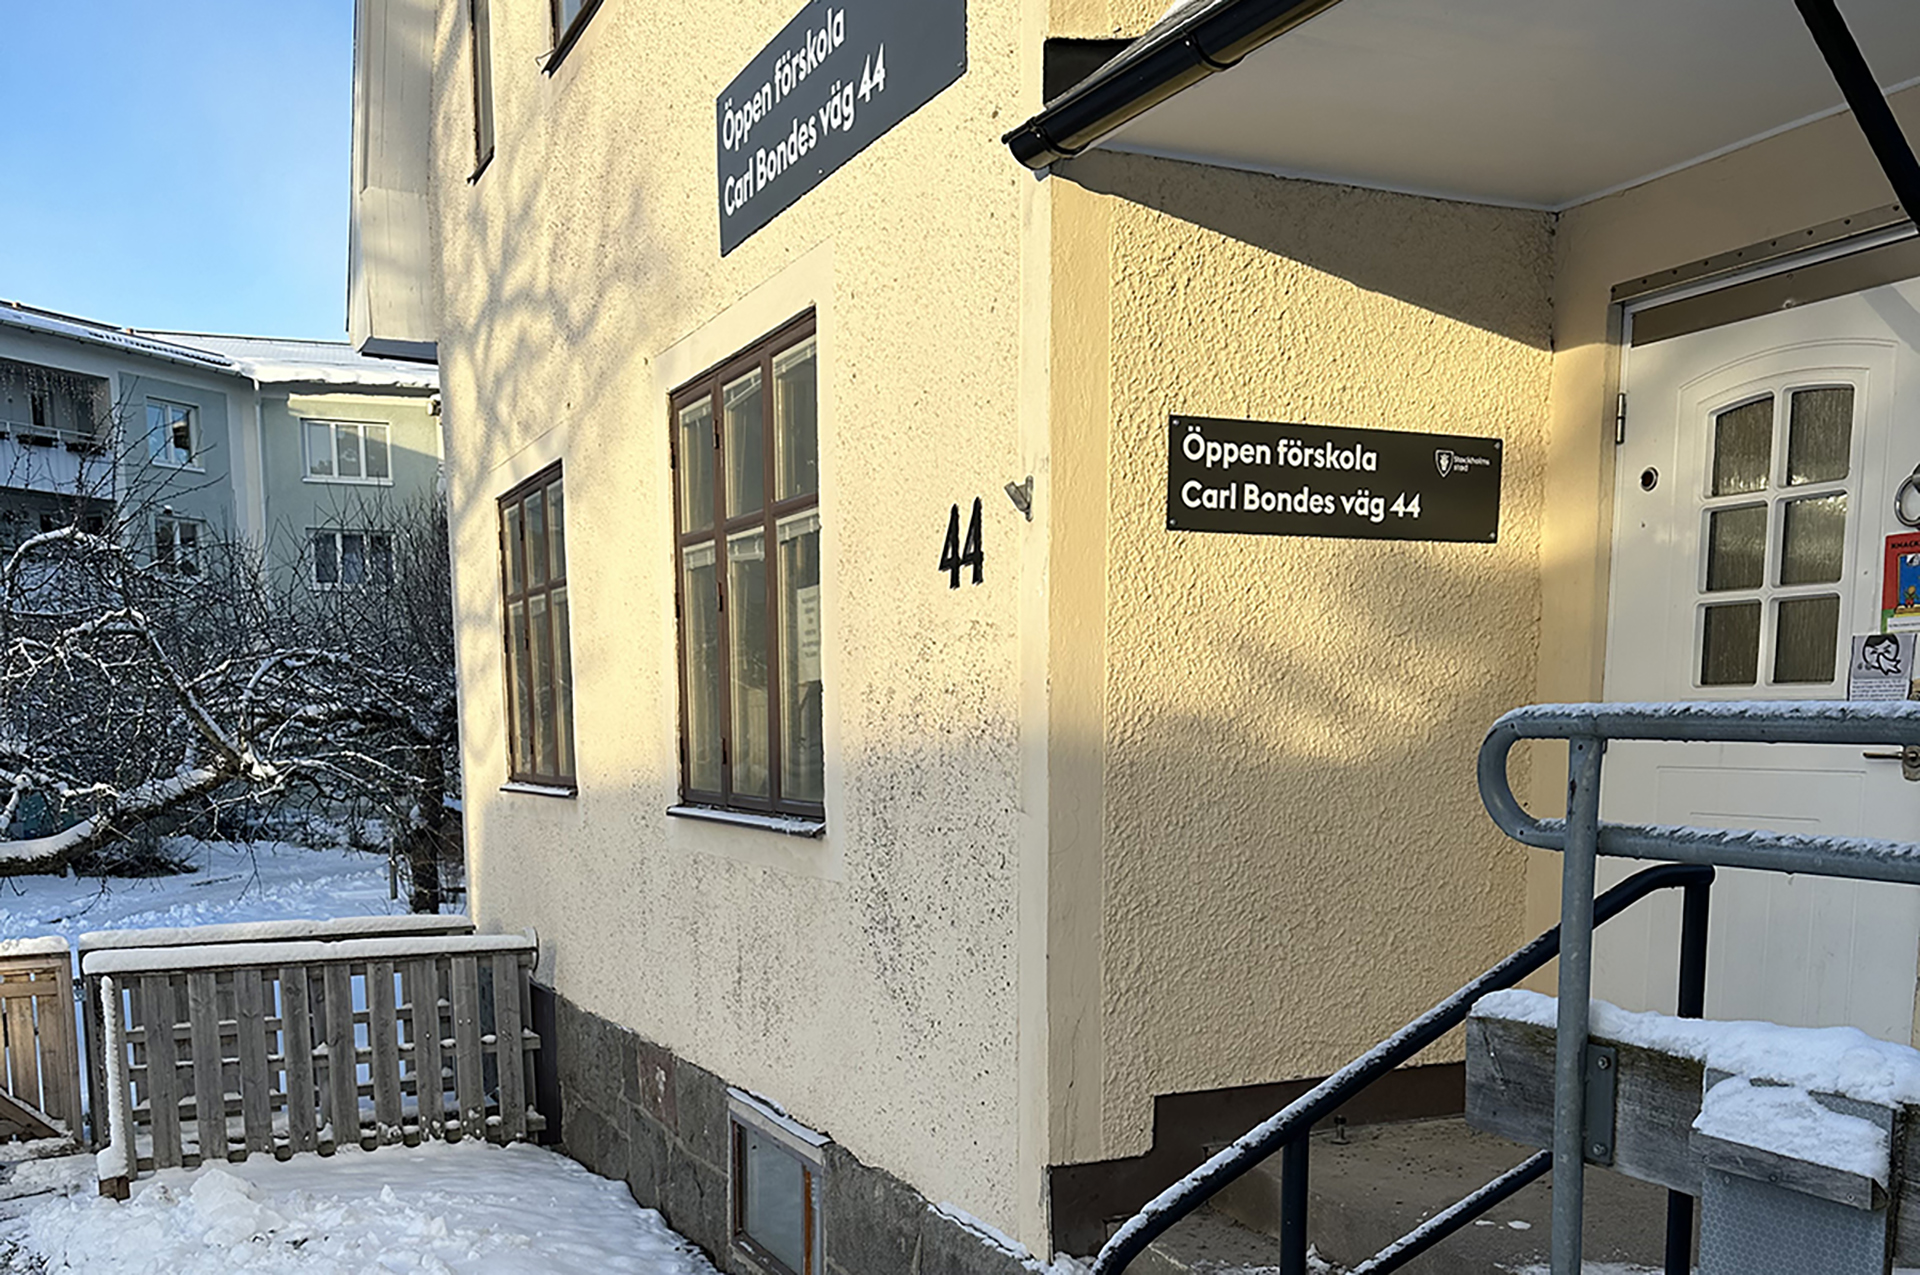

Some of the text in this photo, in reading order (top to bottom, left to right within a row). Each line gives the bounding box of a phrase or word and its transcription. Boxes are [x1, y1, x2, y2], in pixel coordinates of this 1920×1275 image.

[722, 7, 846, 152] Öppen förskola
[723, 43, 886, 216] Carl Bondes väg 44
[1182, 425, 1377, 471] Öppen förskola
[938, 496, 985, 590] 44
[1181, 480, 1421, 522] Carl Bondes väg 44
